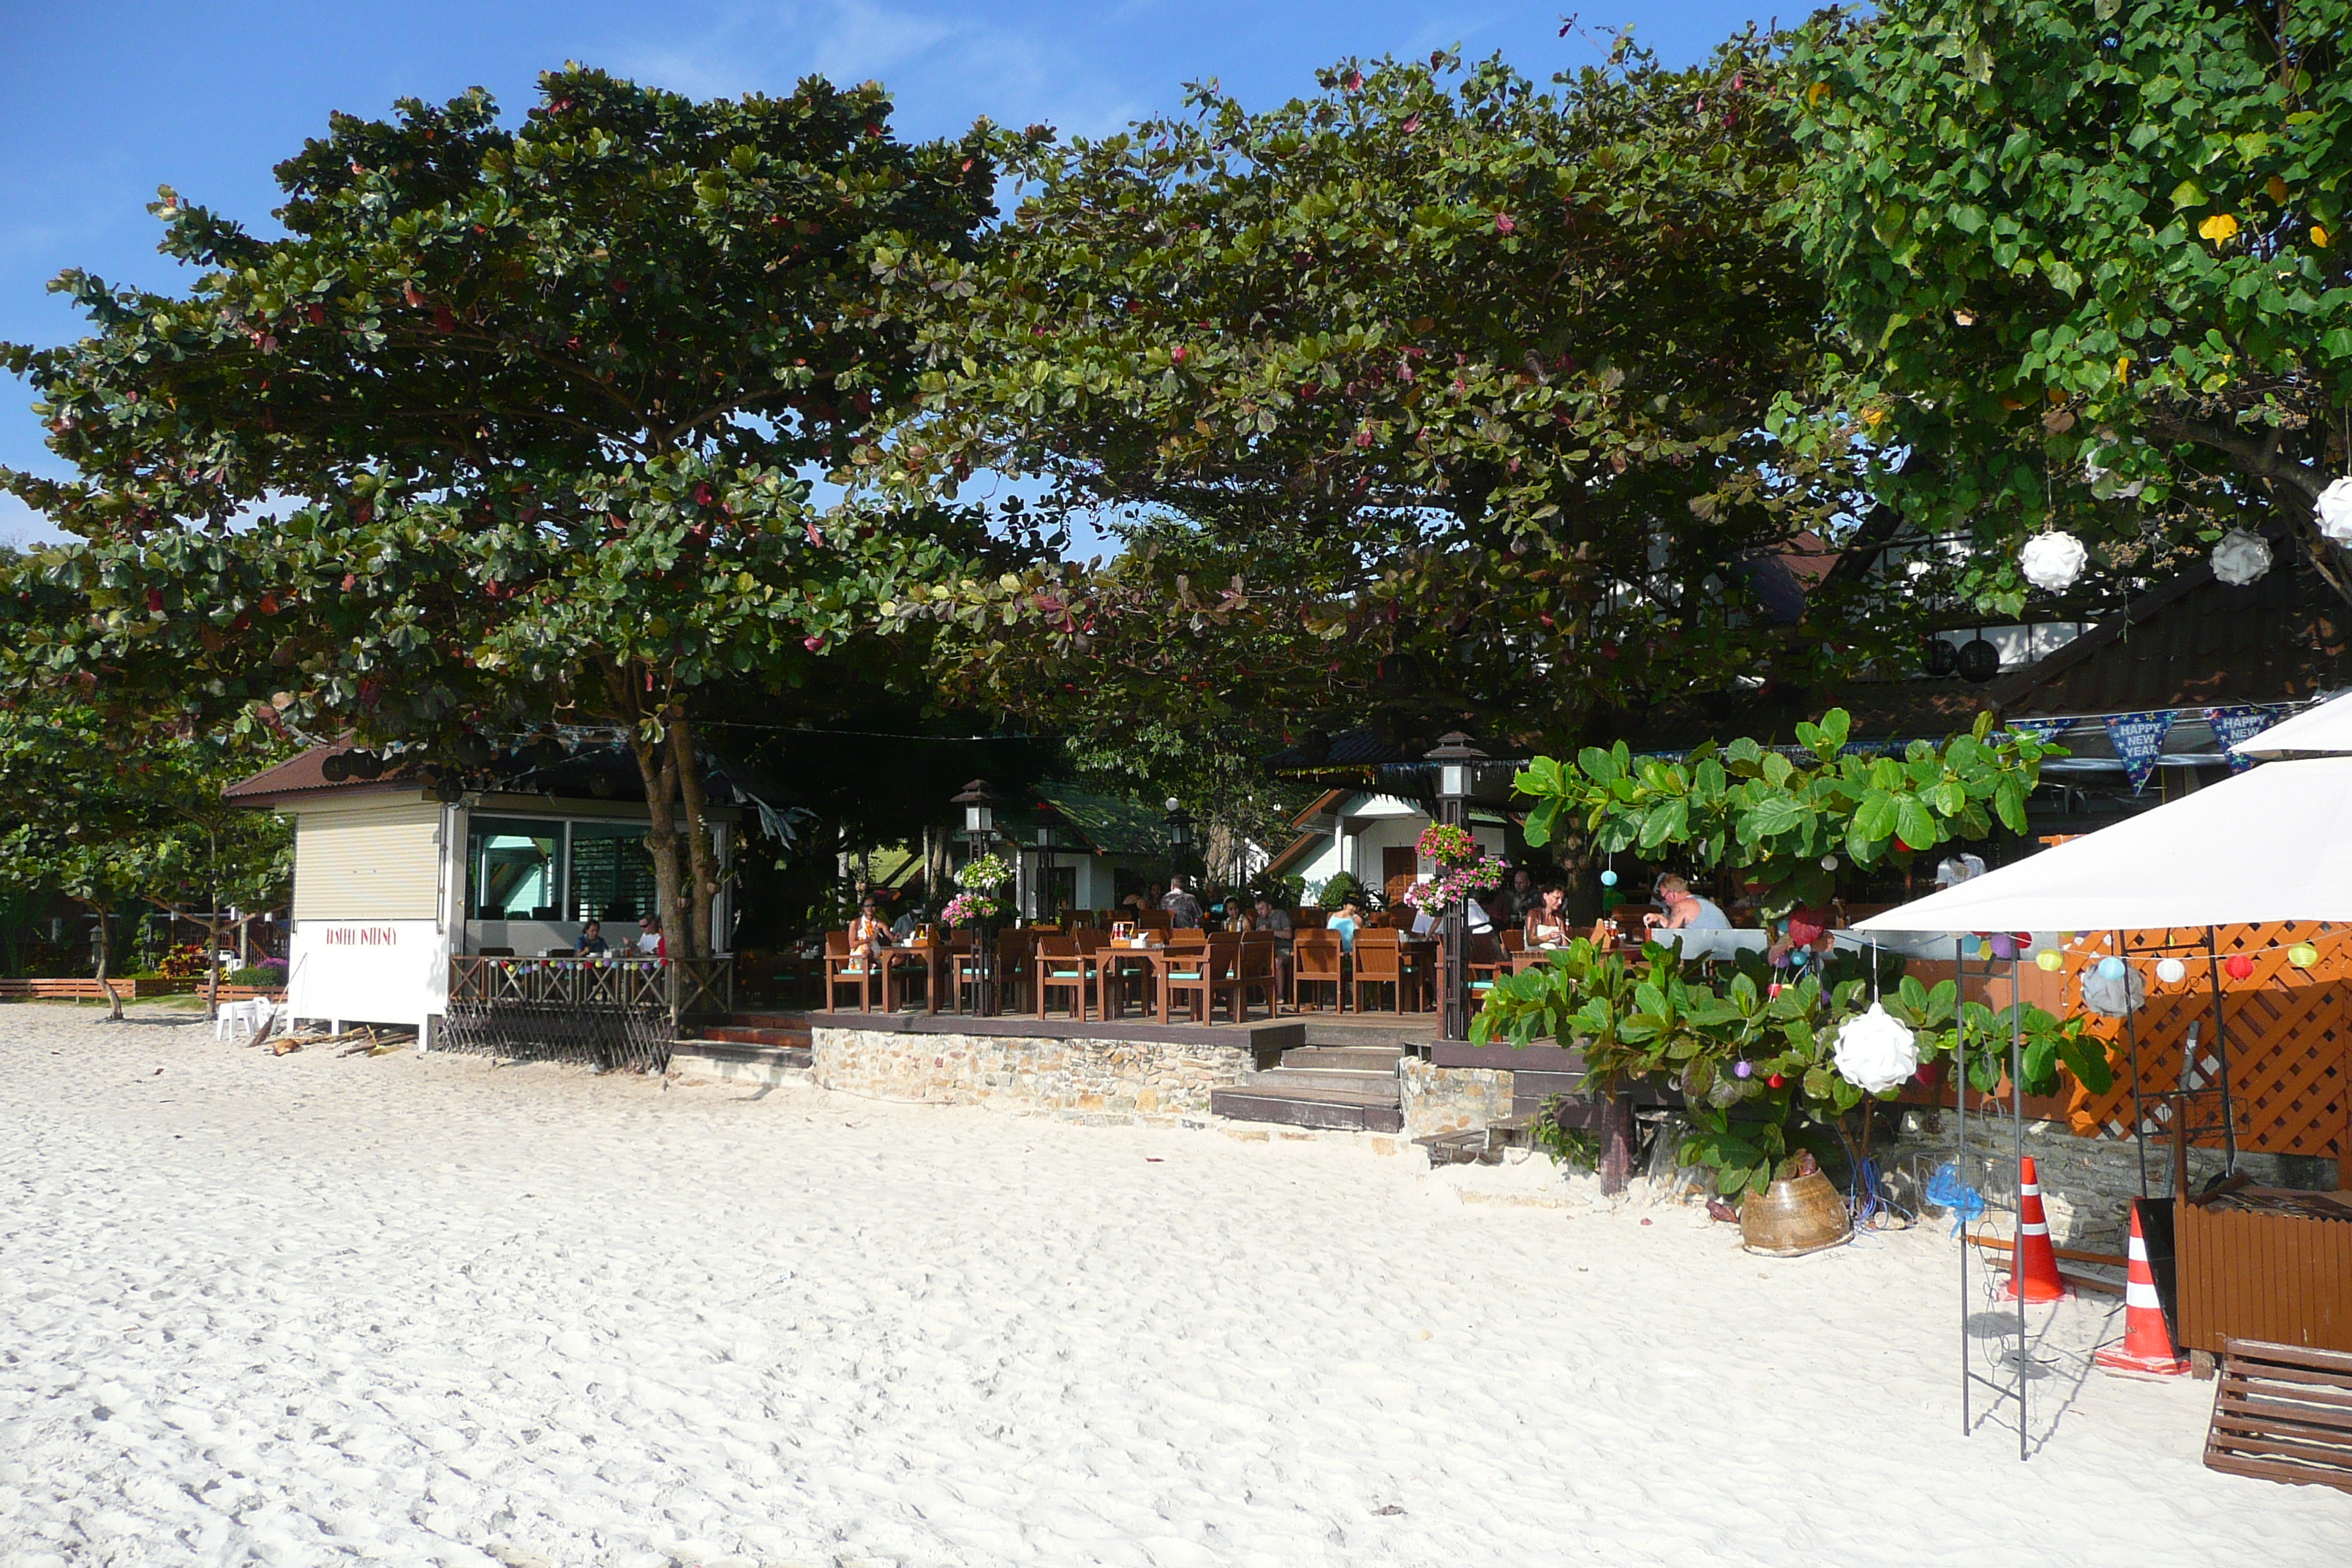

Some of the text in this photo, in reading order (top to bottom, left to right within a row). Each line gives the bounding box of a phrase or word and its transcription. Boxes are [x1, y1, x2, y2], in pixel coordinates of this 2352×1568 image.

[2223, 717, 2266, 728] HAPPY
[2121, 723, 2160, 736] HAPPY
[2231, 728, 2259, 738] NEW
[2127, 734, 2155, 745] NEW
[2125, 746, 2157, 757] YEAR
